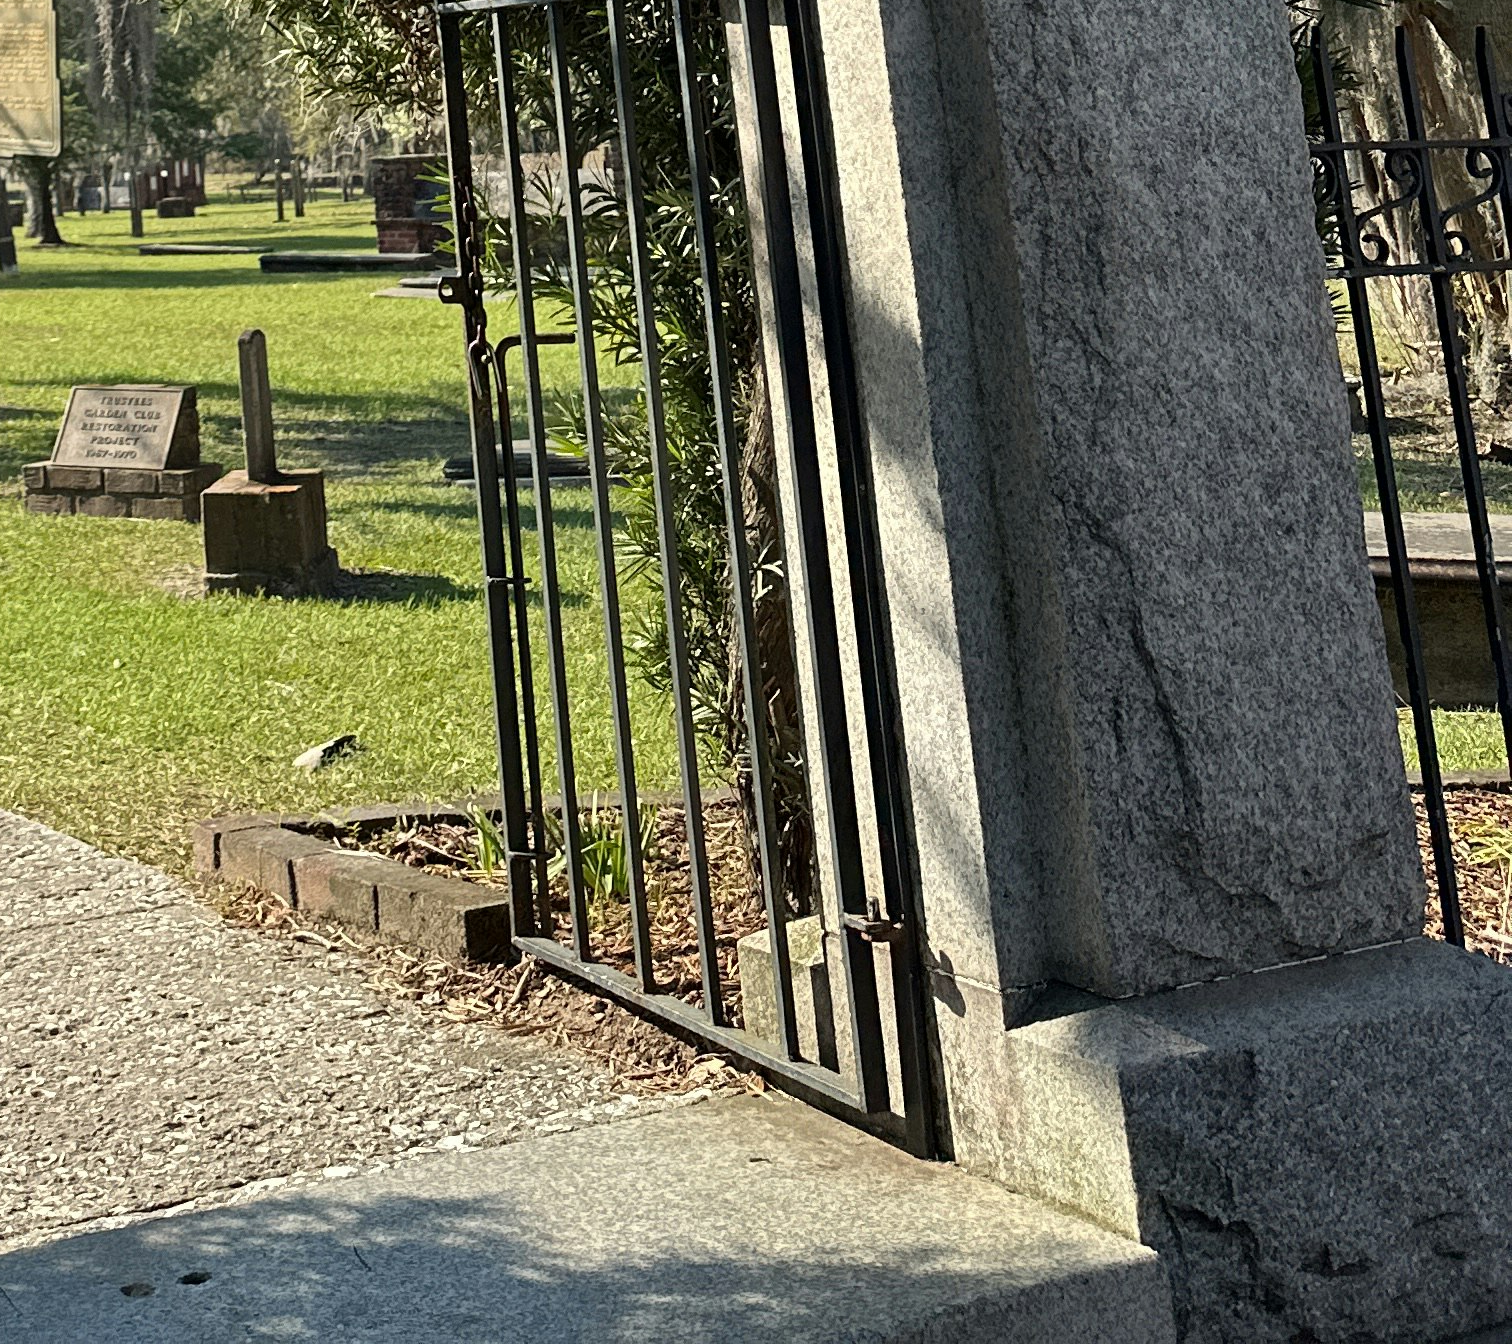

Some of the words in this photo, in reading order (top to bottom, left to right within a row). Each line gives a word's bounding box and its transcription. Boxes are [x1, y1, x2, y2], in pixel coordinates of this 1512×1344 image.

[100, 396, 153, 407] TRUSTEES
[83, 408, 127, 419] GARDEN
[134, 410, 161, 420] CLUB
[80, 421, 159, 433] RESTORATION
[89, 435, 140, 446] PROJECT
